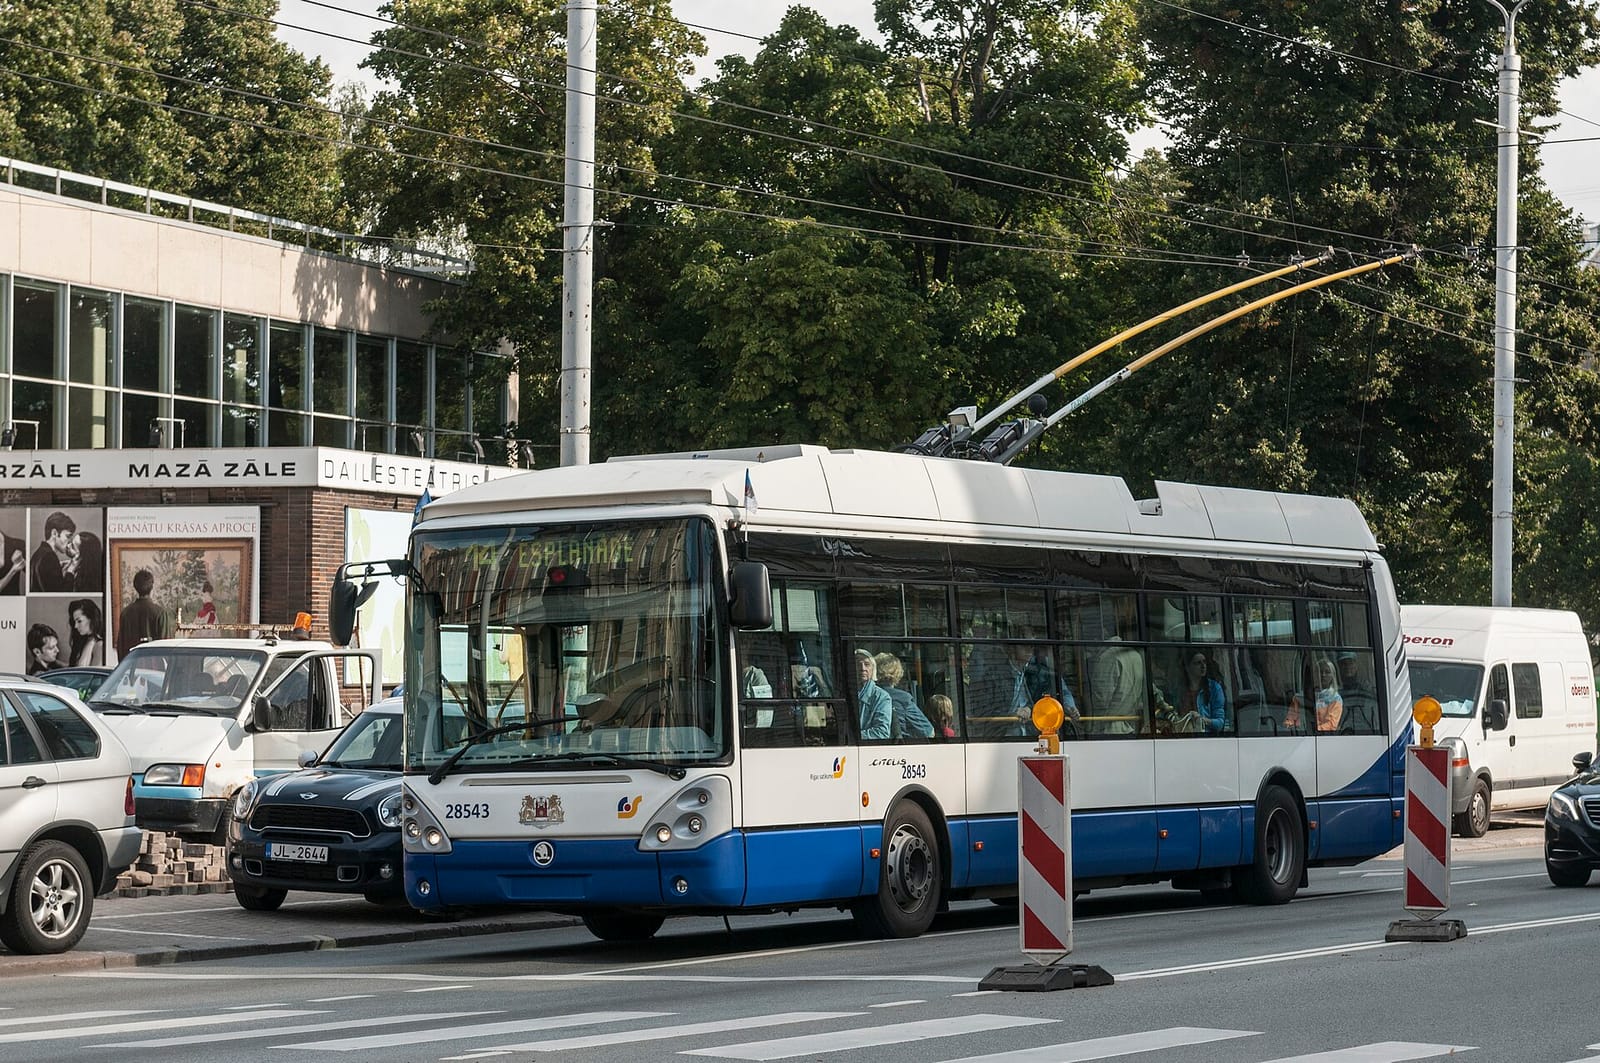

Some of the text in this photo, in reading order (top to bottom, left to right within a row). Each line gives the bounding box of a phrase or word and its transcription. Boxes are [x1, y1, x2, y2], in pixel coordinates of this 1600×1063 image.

[128, 458, 297, 478] MAZĀ ZĀLE
[108, 521, 257, 533] GRANĀTU KRĀSAS APROCE
[901, 764, 926, 779] 28543
[445, 803, 490, 819] 28543
[273, 845, 326, 860] JL-2644
